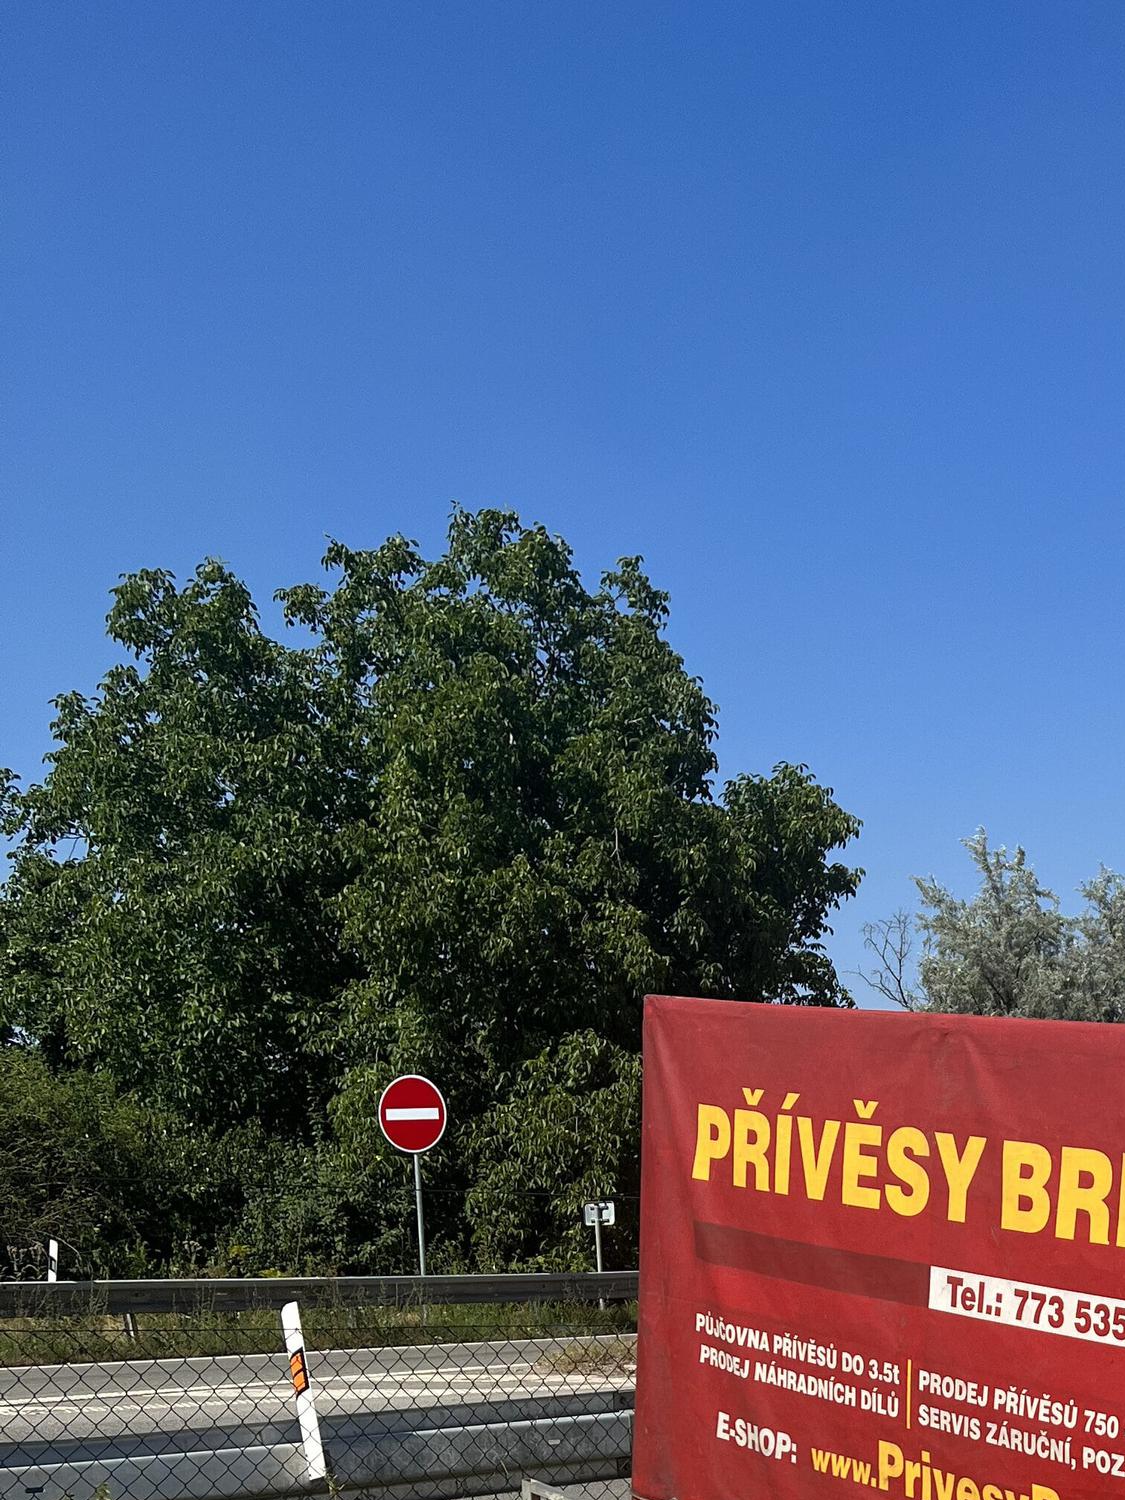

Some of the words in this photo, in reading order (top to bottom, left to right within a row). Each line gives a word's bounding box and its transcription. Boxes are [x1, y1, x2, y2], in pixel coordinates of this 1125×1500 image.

[691, 1087, 987, 1223] PŘÍVĚSY
[946, 1275, 1003, 1317] Tel.:
[1013, 1288, 1065, 1329] 773
[695, 1311, 770, 1352] PŮJČOVNA
[773, 1332, 838, 1370] PŘÍVĚSŮ
[841, 1351, 865, 1376] DO
[868, 1359, 900, 1385] 3.5t
[699, 1344, 750, 1379] PRODEJ
[754, 1361, 857, 1407] NÁHRADNÍCH
[860, 1387, 899, 1418] DÍLŮ
[716, 1411, 798, 1464] E-SHOP:
[918, 1369, 989, 1407] PRODEJ
[993, 1385, 1078, 1429] PŘÍVĚSŮ
[1083, 1409, 1119, 1439] 750
[918, 1403, 981, 1441] SERVIS
[985, 1422, 1077, 1470] ZÁRUČNÍ,
